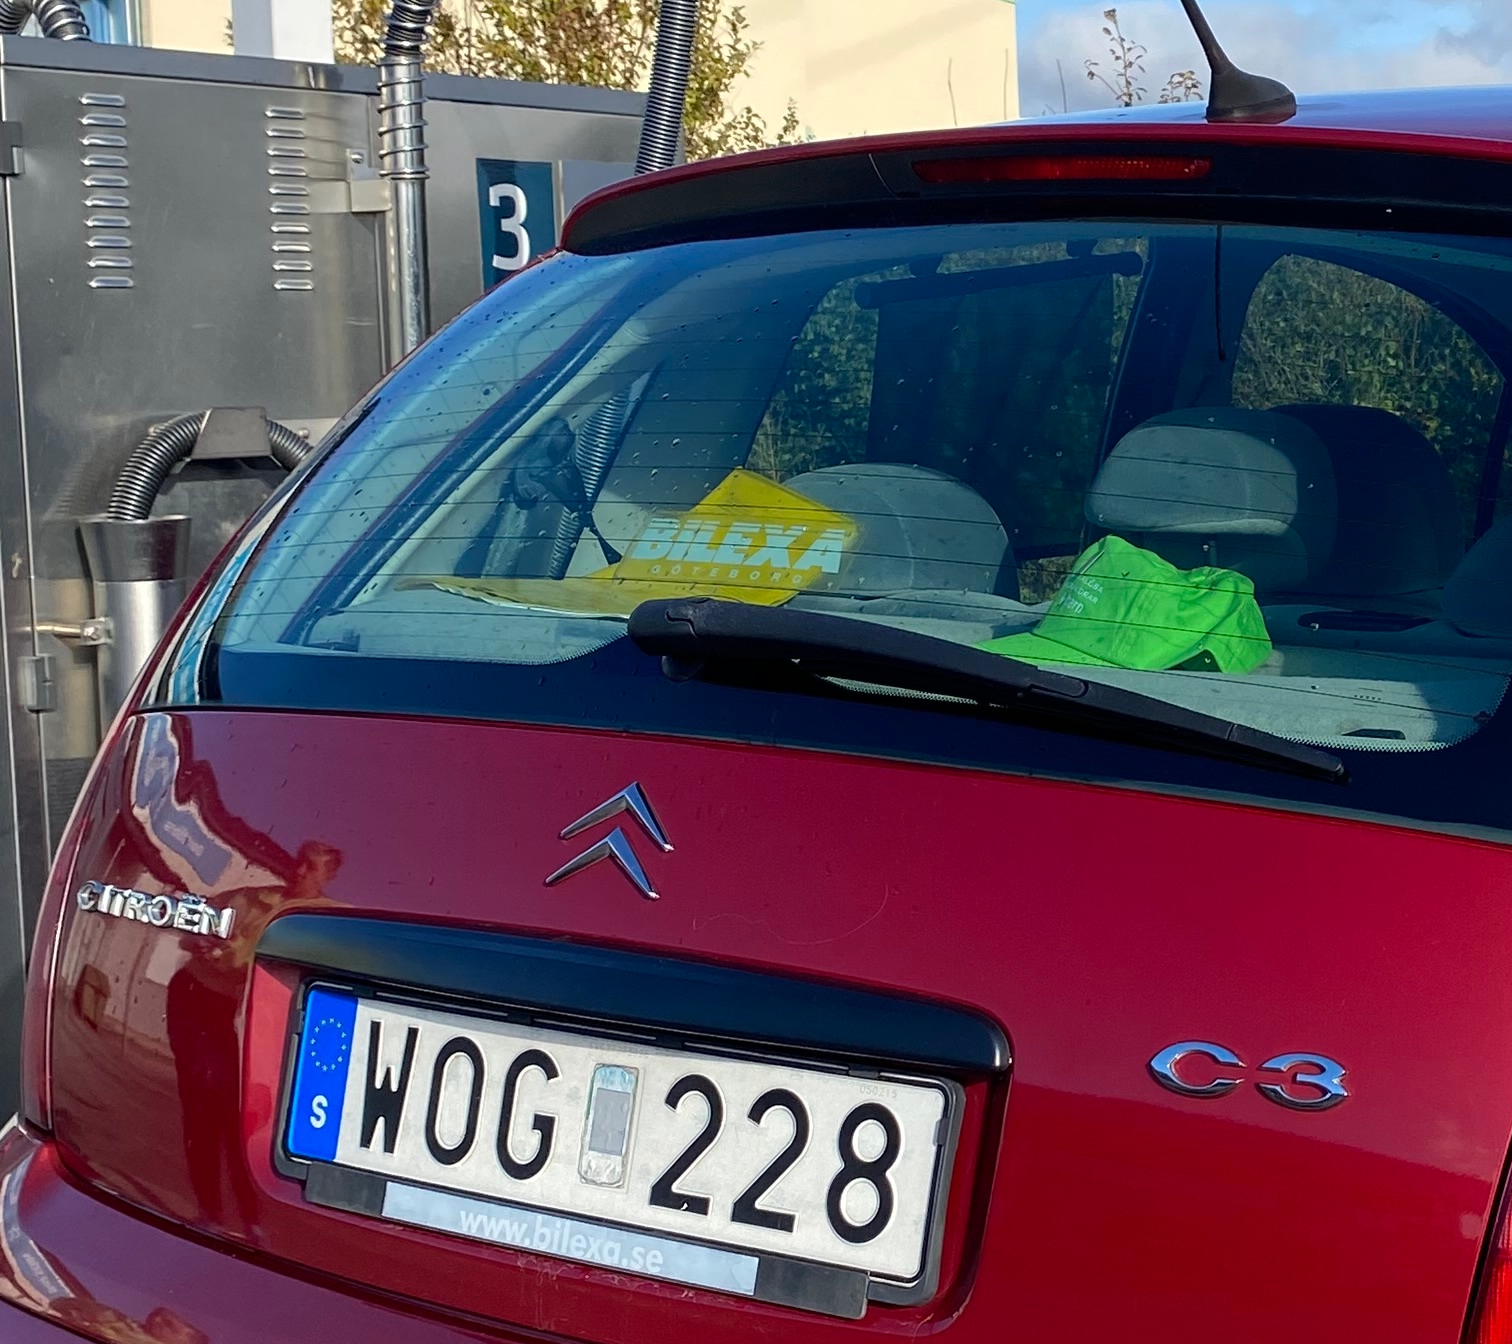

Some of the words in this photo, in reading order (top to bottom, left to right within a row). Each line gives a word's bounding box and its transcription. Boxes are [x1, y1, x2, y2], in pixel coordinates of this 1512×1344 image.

[489, 183, 531, 271] 3
[630, 518, 845, 574] BILEXA
[77, 880, 236, 939] CITROËN
[1150, 1040, 1350, 1111] C3
[309, 1094, 329, 1129] S
[359, 1020, 560, 1181] WOG
[649, 1073, 901, 1244] 228
[459, 1210, 664, 1274] www.bilexa.se
